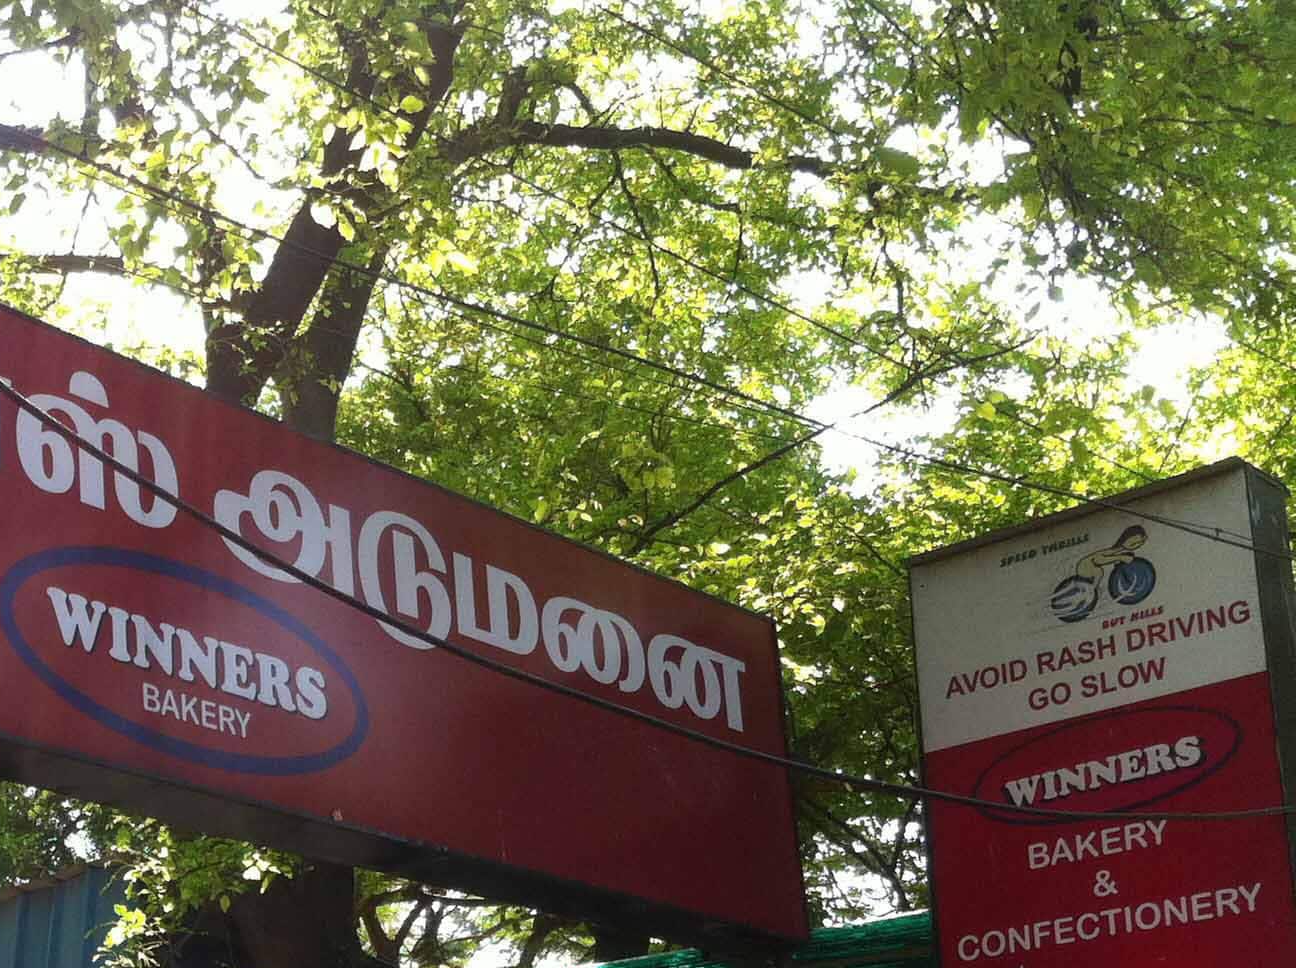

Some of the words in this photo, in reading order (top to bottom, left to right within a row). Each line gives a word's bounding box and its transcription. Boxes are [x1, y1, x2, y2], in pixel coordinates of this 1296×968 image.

[999, 549, 1037, 568] SPEED
[1041, 533, 1089, 555] THRILLS
[213, 469, 746, 732] அடுமனை
[1102, 615, 1126, 630] BUT
[1130, 605, 1165, 623] KILLS
[46, 586, 328, 720] WINNERS
[945, 659, 1028, 699] AVOID
[1036, 634, 1116, 675] RASH
[1126, 599, 1251, 652] DRIVING
[141, 682, 251, 739] BAKERY
[1028, 681, 1072, 711] GO
[1081, 657, 1167, 698] SLOW
[1005, 735, 1204, 808] WINNERS
[1027, 819, 1168, 870] BAKERY
[1093, 869, 1119, 897] &
[957, 882, 1262, 962] CONFECTIONERY
